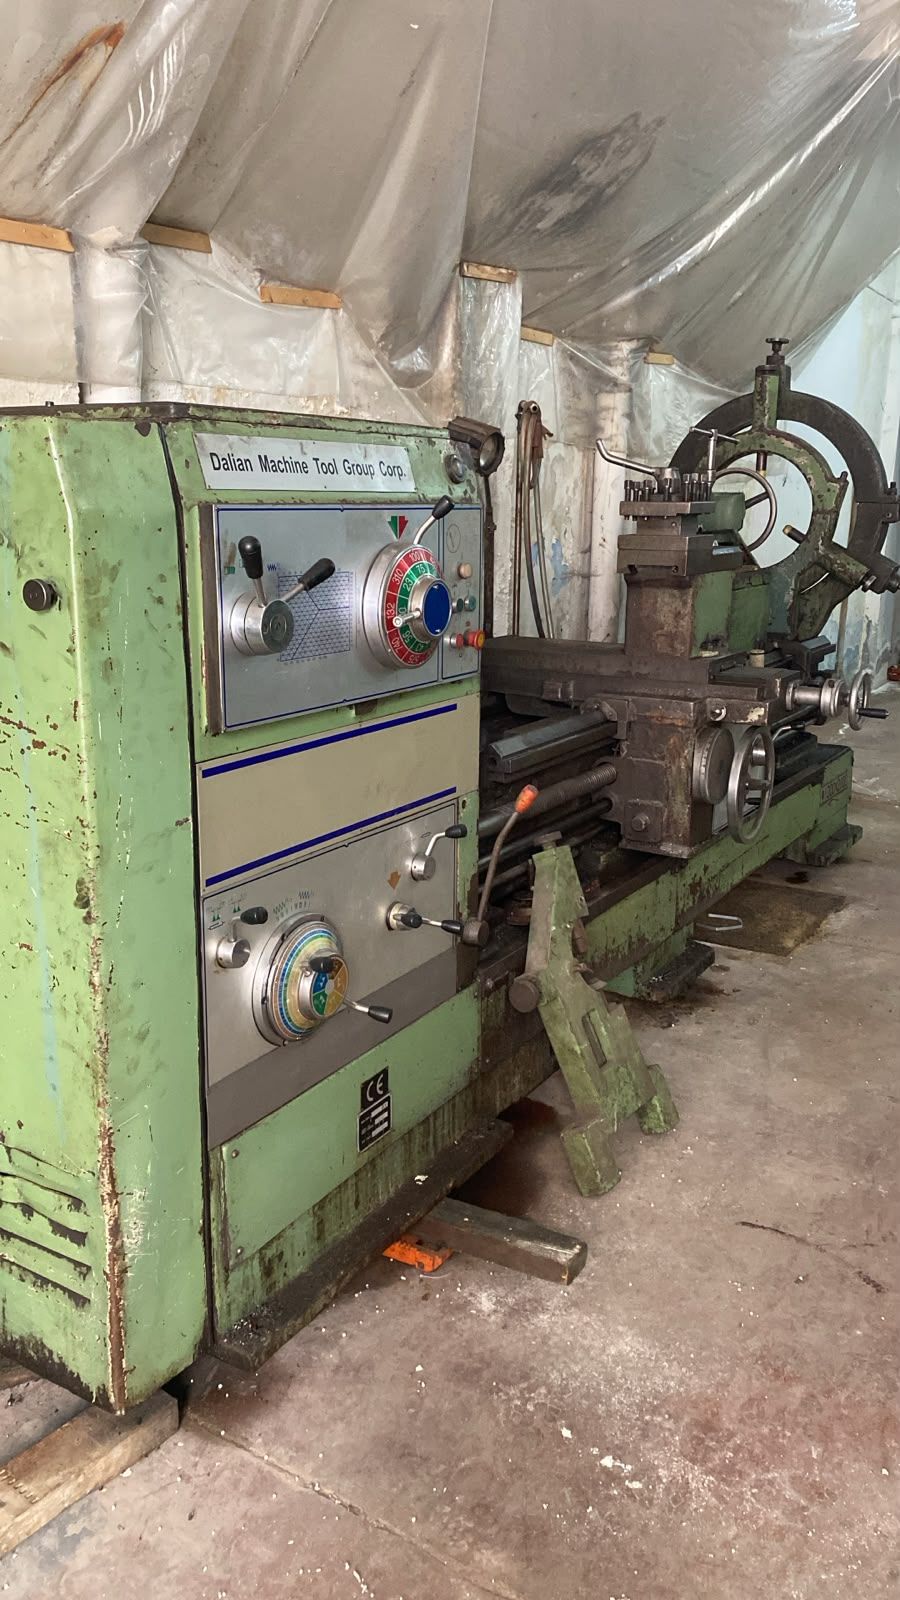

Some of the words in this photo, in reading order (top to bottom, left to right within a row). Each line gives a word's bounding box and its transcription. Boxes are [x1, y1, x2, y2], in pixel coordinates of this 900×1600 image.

[209, 452, 253, 472] Dalian
[258, 454, 309, 474] Machine
[313, 457, 338, 475] Tool
[342, 459, 375, 480] Group
[379, 460, 406, 480] Corp.
[392, 568, 404, 585] 310
[403, 577, 414, 592] 23
[386, 602, 395, 619] 132
[366, 1073, 384, 1102] CE
